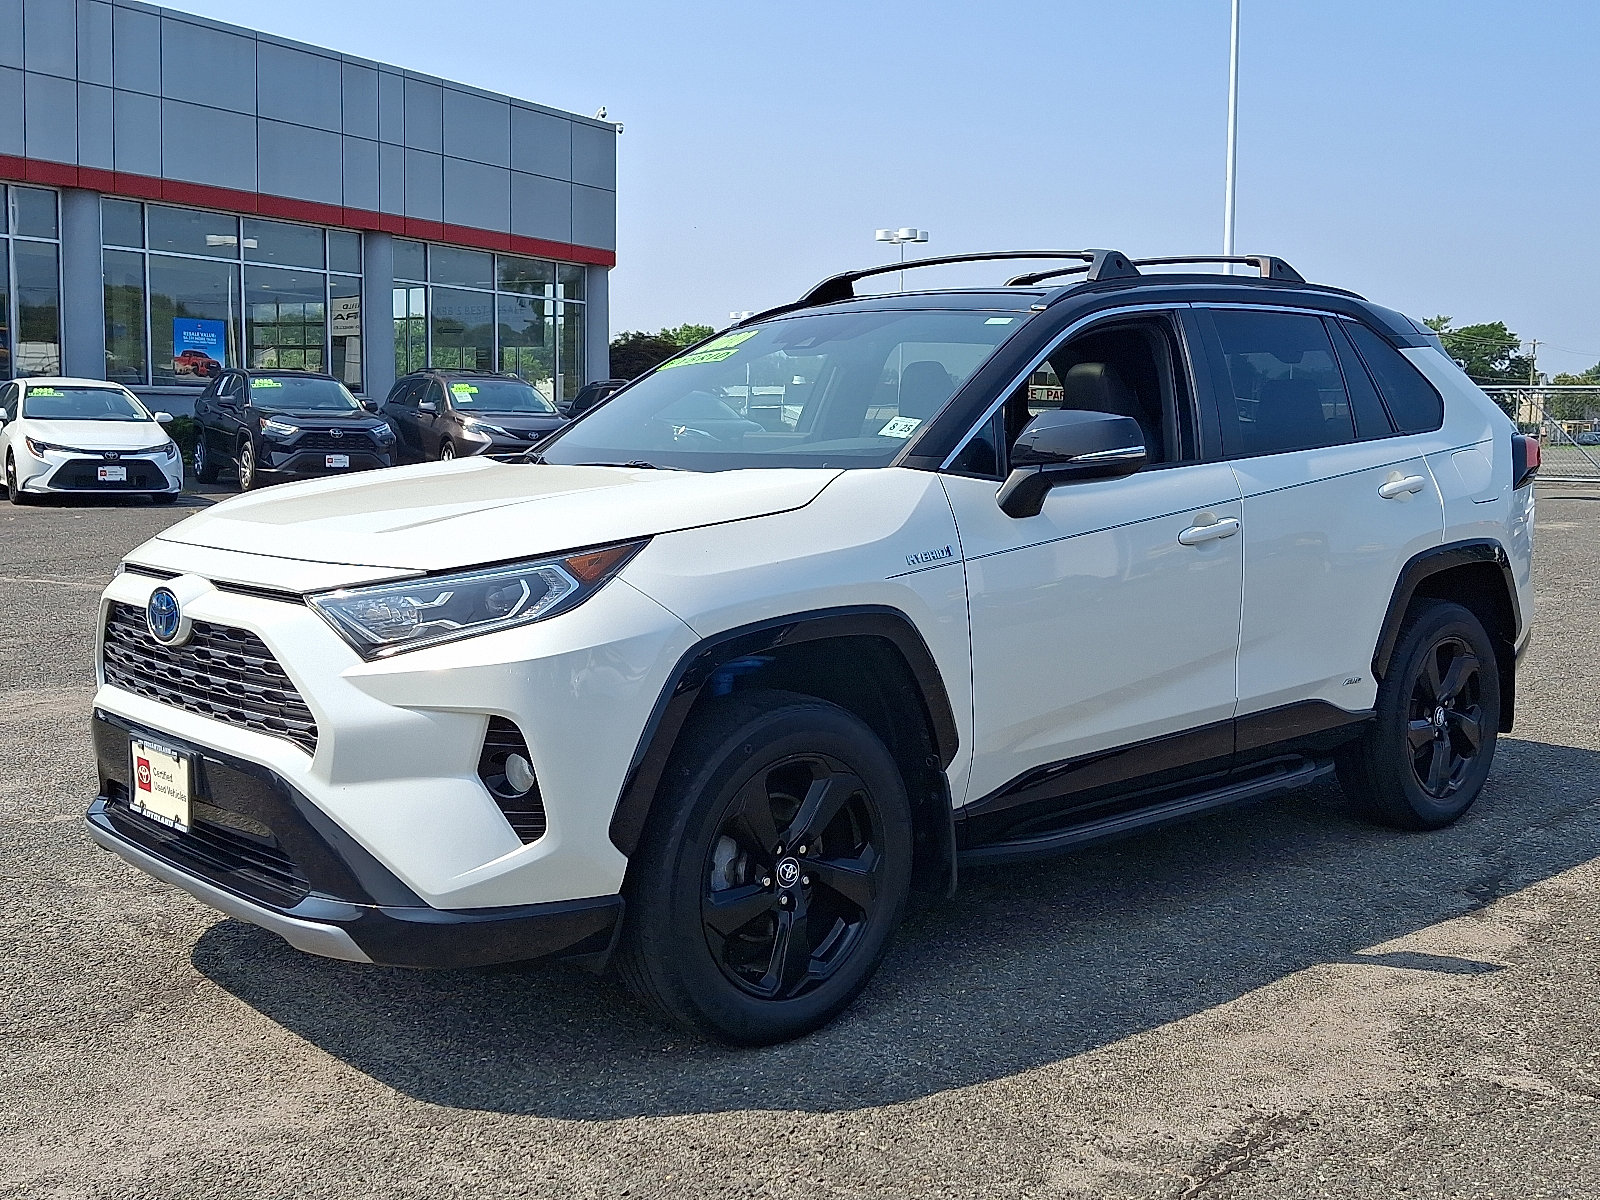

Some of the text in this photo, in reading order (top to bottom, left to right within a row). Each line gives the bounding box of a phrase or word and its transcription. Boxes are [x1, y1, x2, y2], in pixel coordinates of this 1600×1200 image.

[905, 546, 949, 566] HYBRID
[152, 767, 174, 783] Certified
[153, 781, 187, 803] Used Vehicles
